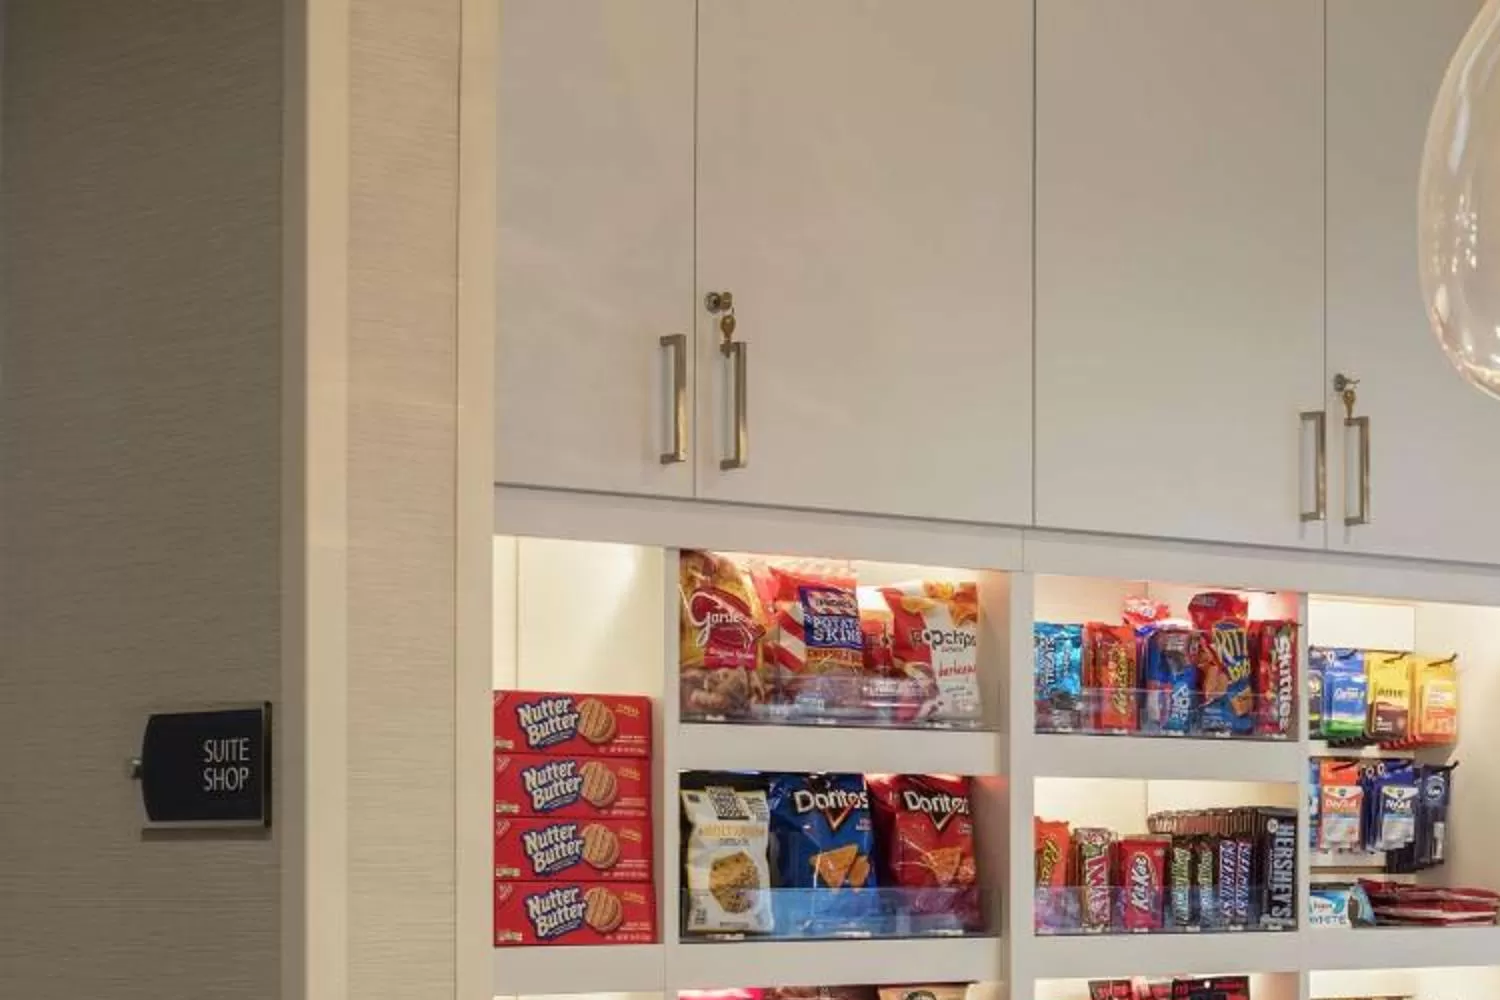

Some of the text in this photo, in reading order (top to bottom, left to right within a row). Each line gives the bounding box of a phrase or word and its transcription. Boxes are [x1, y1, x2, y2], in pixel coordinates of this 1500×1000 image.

[518, 698, 572, 725] Nutter
[527, 712, 580, 746] Butter
[203, 738, 251, 764] SUITE
[203, 767, 249, 792] SHOP
[522, 759, 576, 788] Nutter
[532, 774, 583, 811] Butter
[794, 789, 869, 812] Doritos
[903, 790, 970, 814] Doritos
[523, 823, 577, 852] Nutter
[534, 838, 584, 875] Butter
[1271, 823, 1294, 919] HERSHEY'S
[527, 886, 580, 915] Nutter
[536, 901, 587, 938] Butter
